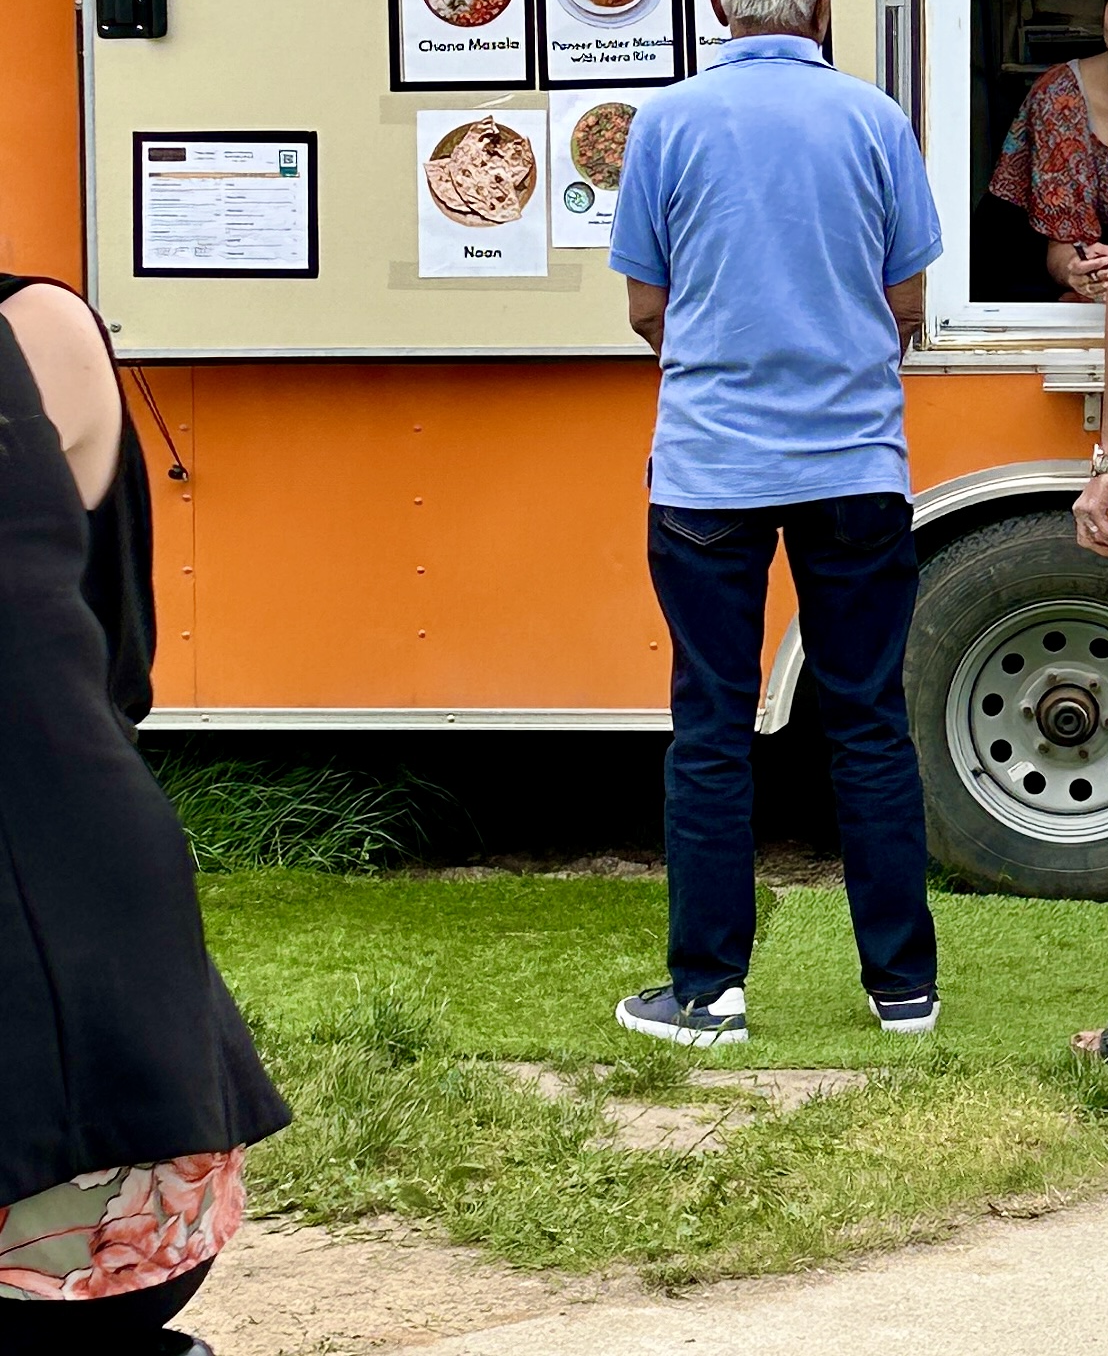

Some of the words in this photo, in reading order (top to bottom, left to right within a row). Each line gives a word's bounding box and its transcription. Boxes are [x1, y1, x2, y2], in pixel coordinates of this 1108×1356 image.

[418, 39, 465, 52] Chana
[468, 36, 520, 51] Masala
[571, 52, 597, 63] with
[464, 245, 502, 258] Naan
